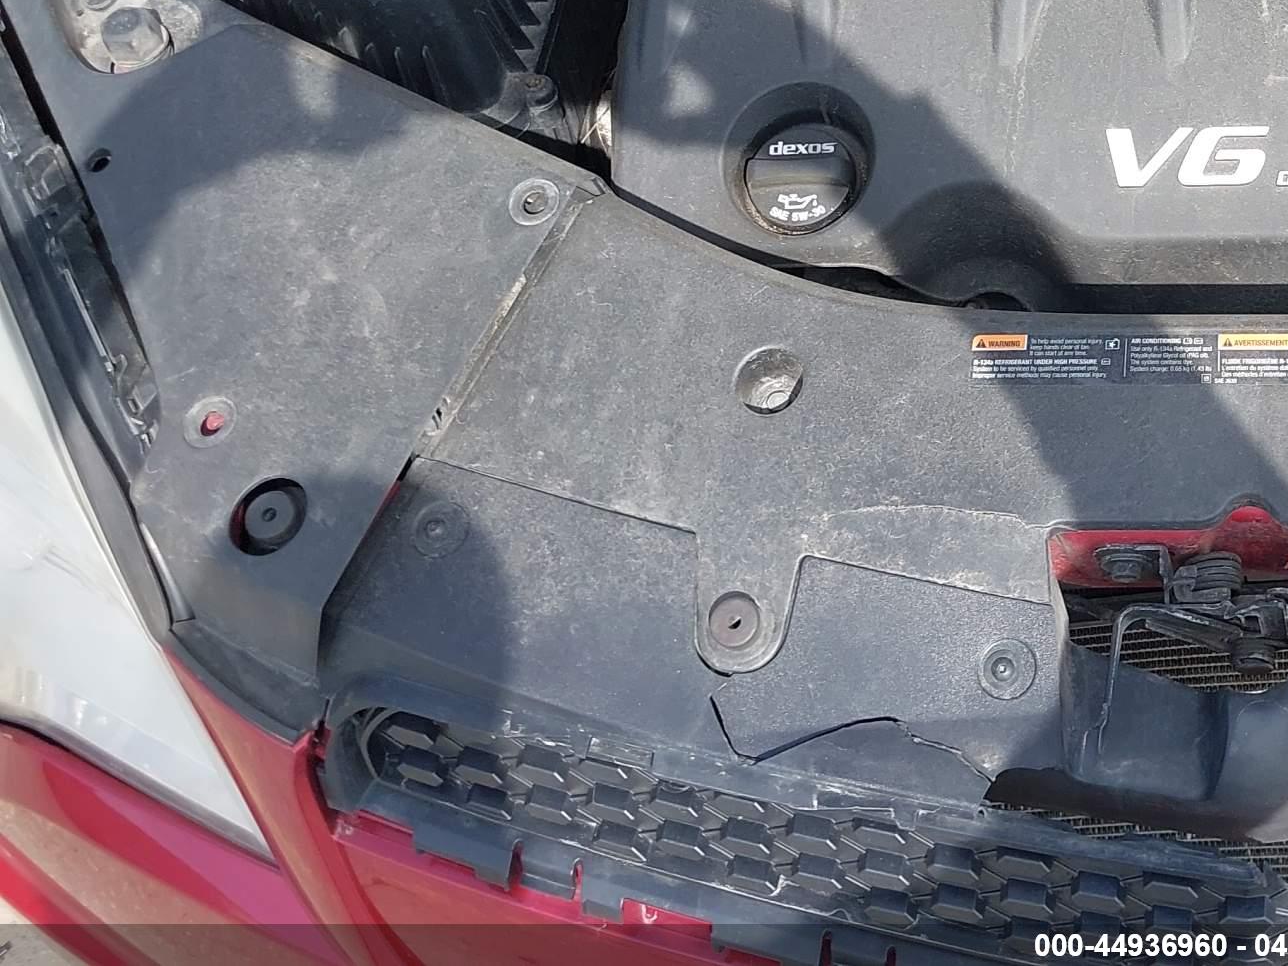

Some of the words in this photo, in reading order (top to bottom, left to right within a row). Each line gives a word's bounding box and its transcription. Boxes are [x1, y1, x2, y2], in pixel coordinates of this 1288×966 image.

[769, 141, 838, 156] dexos
[1105, 126, 1270, 187] V6
[769, 206, 790, 221] SAE
[791, 205, 826, 222] 5W-30
